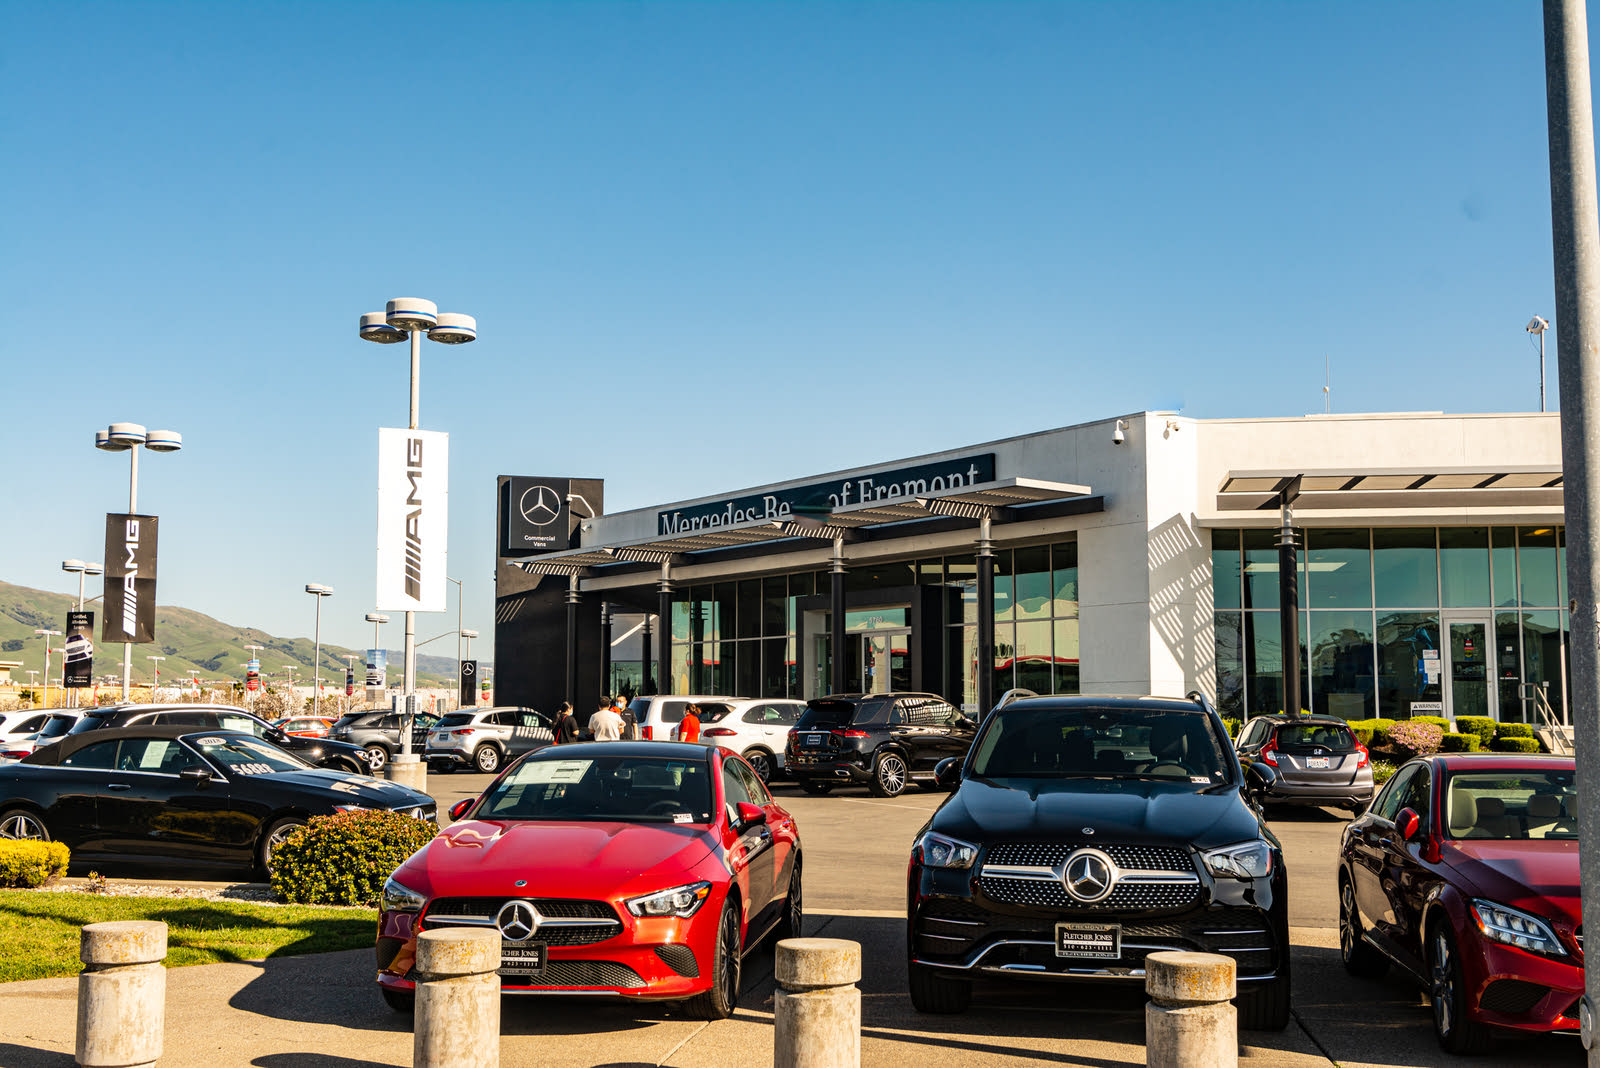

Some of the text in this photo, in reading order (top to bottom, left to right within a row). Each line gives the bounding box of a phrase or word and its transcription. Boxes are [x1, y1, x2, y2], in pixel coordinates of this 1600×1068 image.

[662, 464, 979, 535] Mercedes-Be of Fremont
[521, 949, 539, 958] JONES
